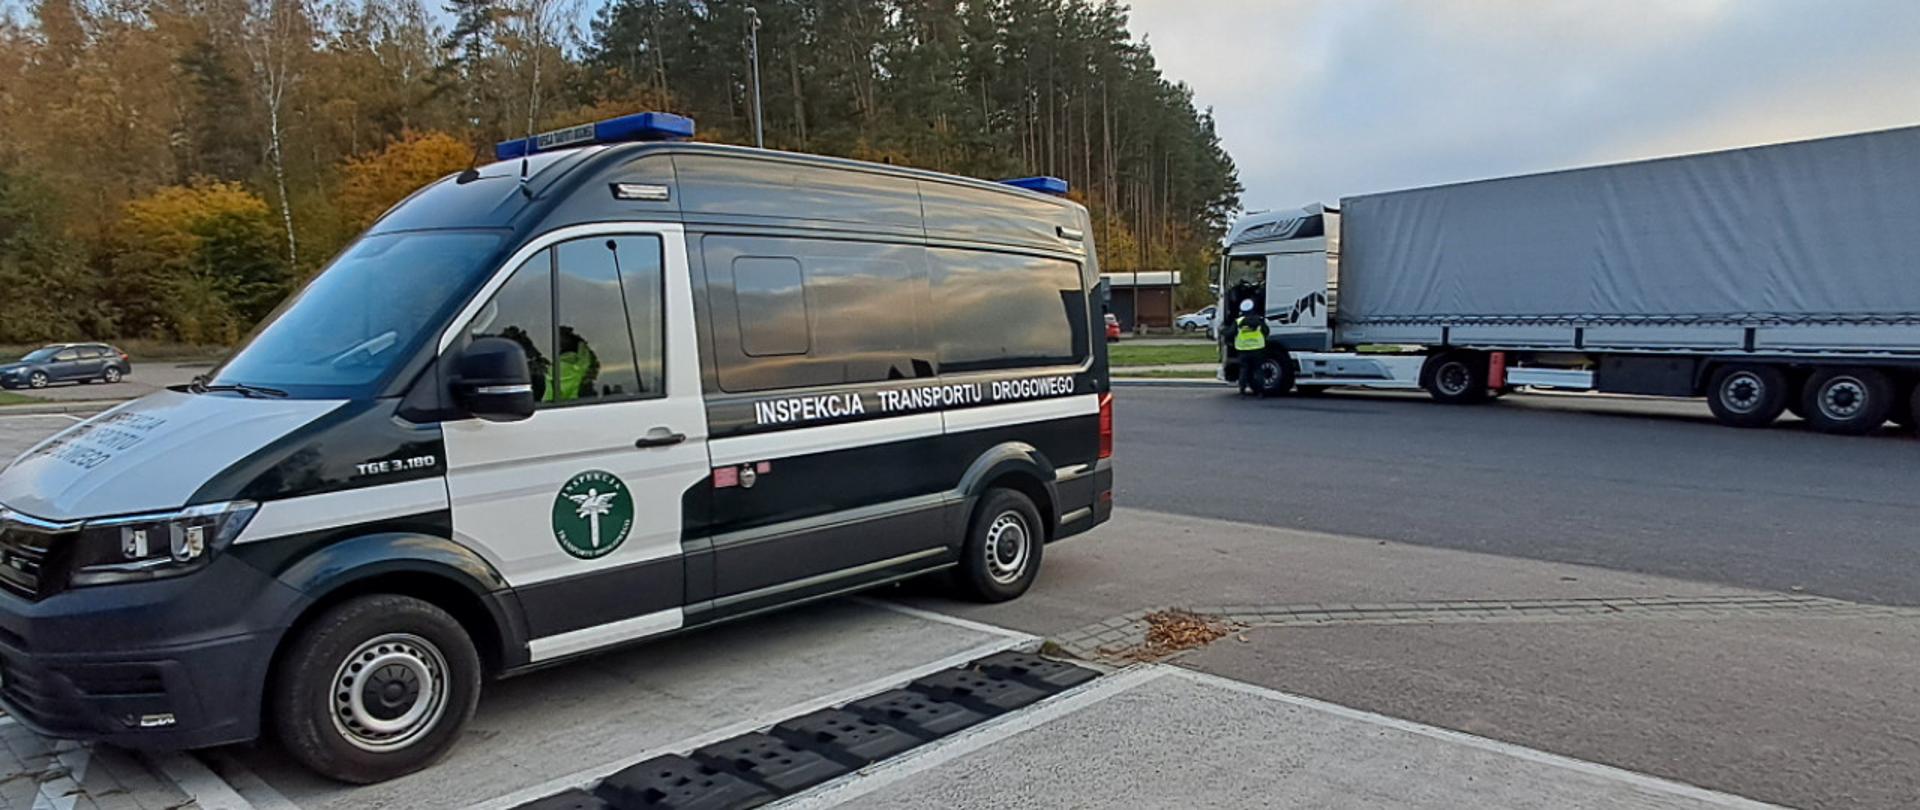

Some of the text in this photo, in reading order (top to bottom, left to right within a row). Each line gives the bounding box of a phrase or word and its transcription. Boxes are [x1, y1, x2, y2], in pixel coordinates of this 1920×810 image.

[755, 376, 1075, 424] INSPEKCJA TRANSPORTU DROGOWEGO
[356, 455, 435, 475] TGE 3.180
